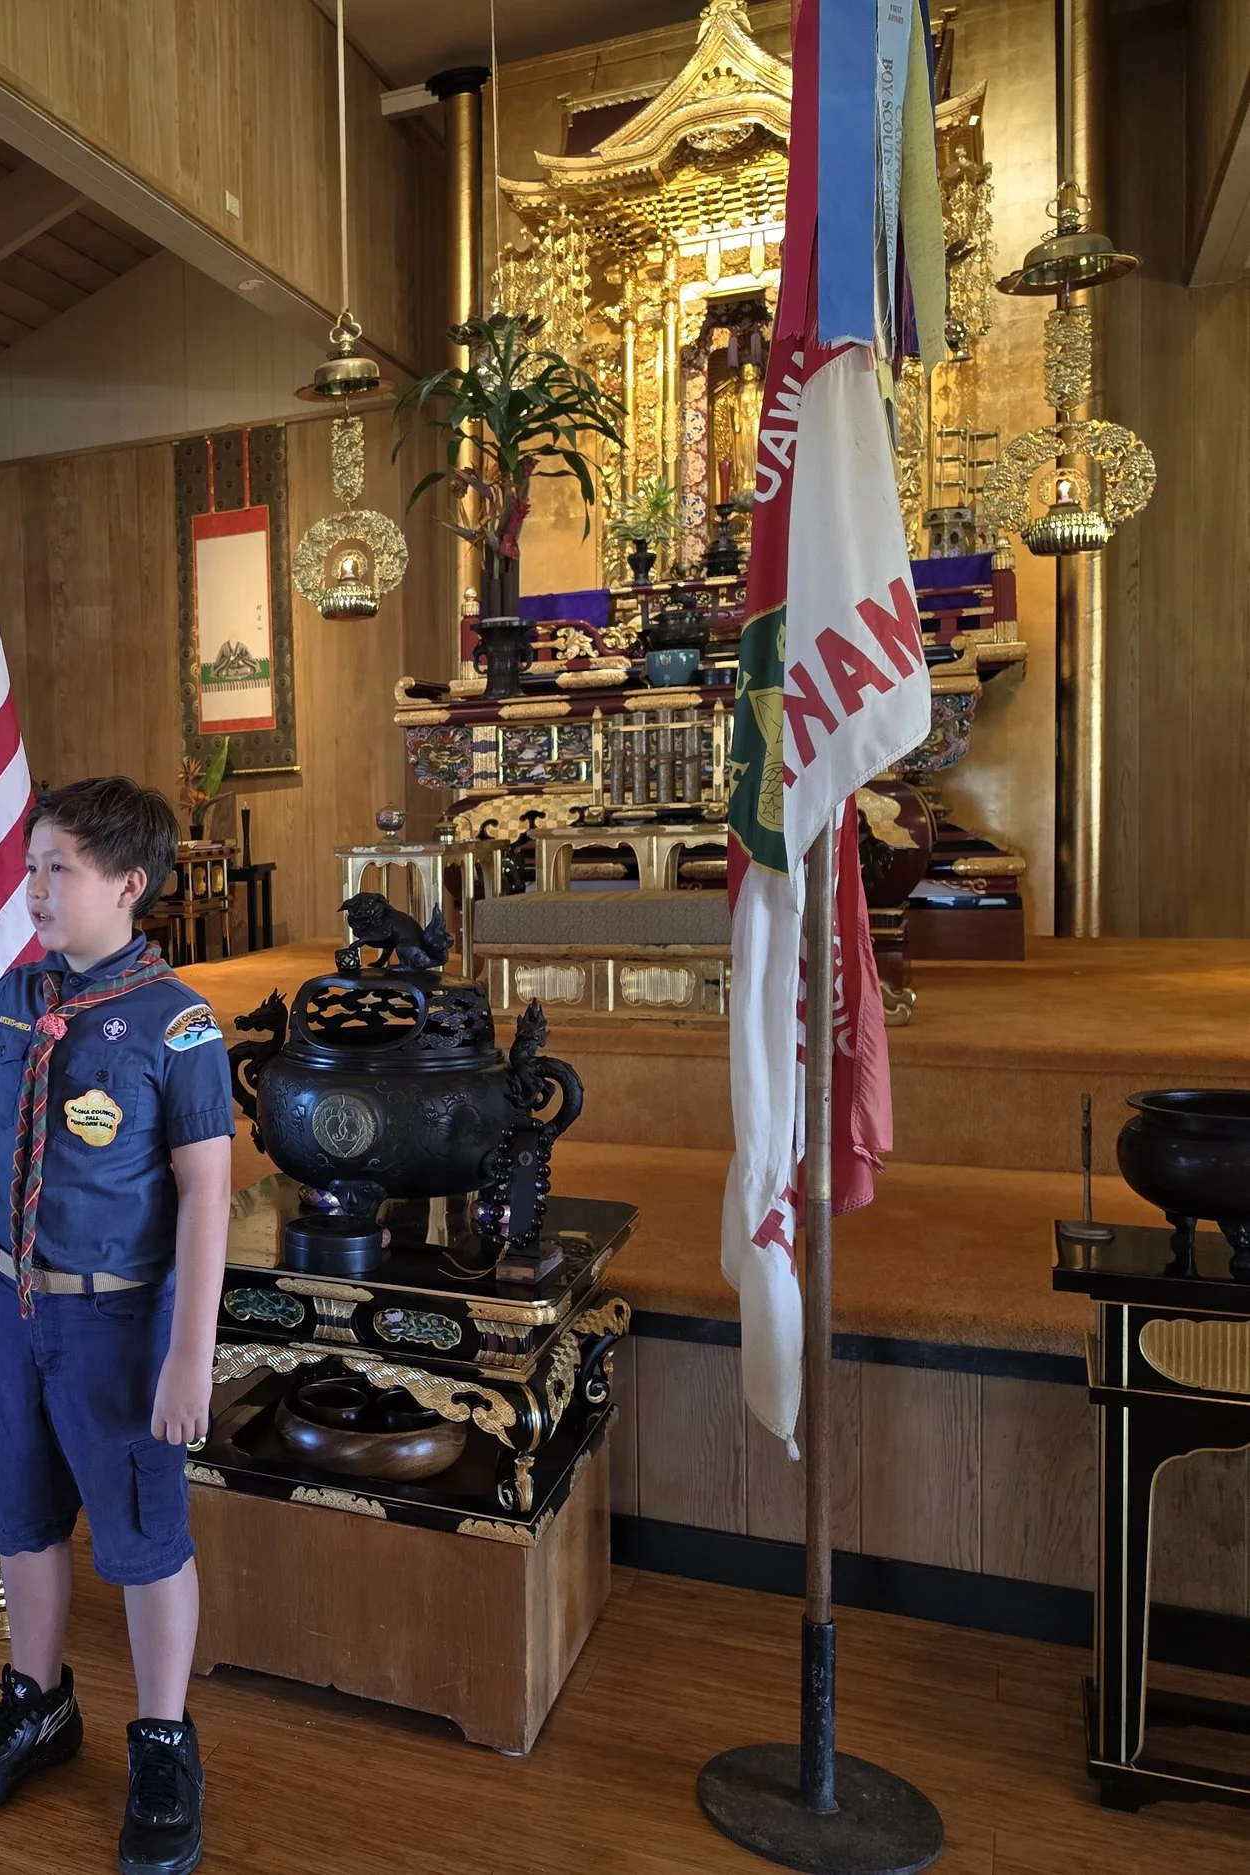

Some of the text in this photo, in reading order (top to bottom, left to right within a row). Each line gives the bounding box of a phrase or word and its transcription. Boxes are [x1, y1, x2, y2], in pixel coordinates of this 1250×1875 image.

[881, 56, 894, 97] BOY
[882, 99, 894, 167] SCOUTS
[884, 184, 895, 263] AMERICA
[70, 1105, 117, 1120] ALOHA COUNCIL
[70, 1118, 113, 1130] POPCORN SALE
